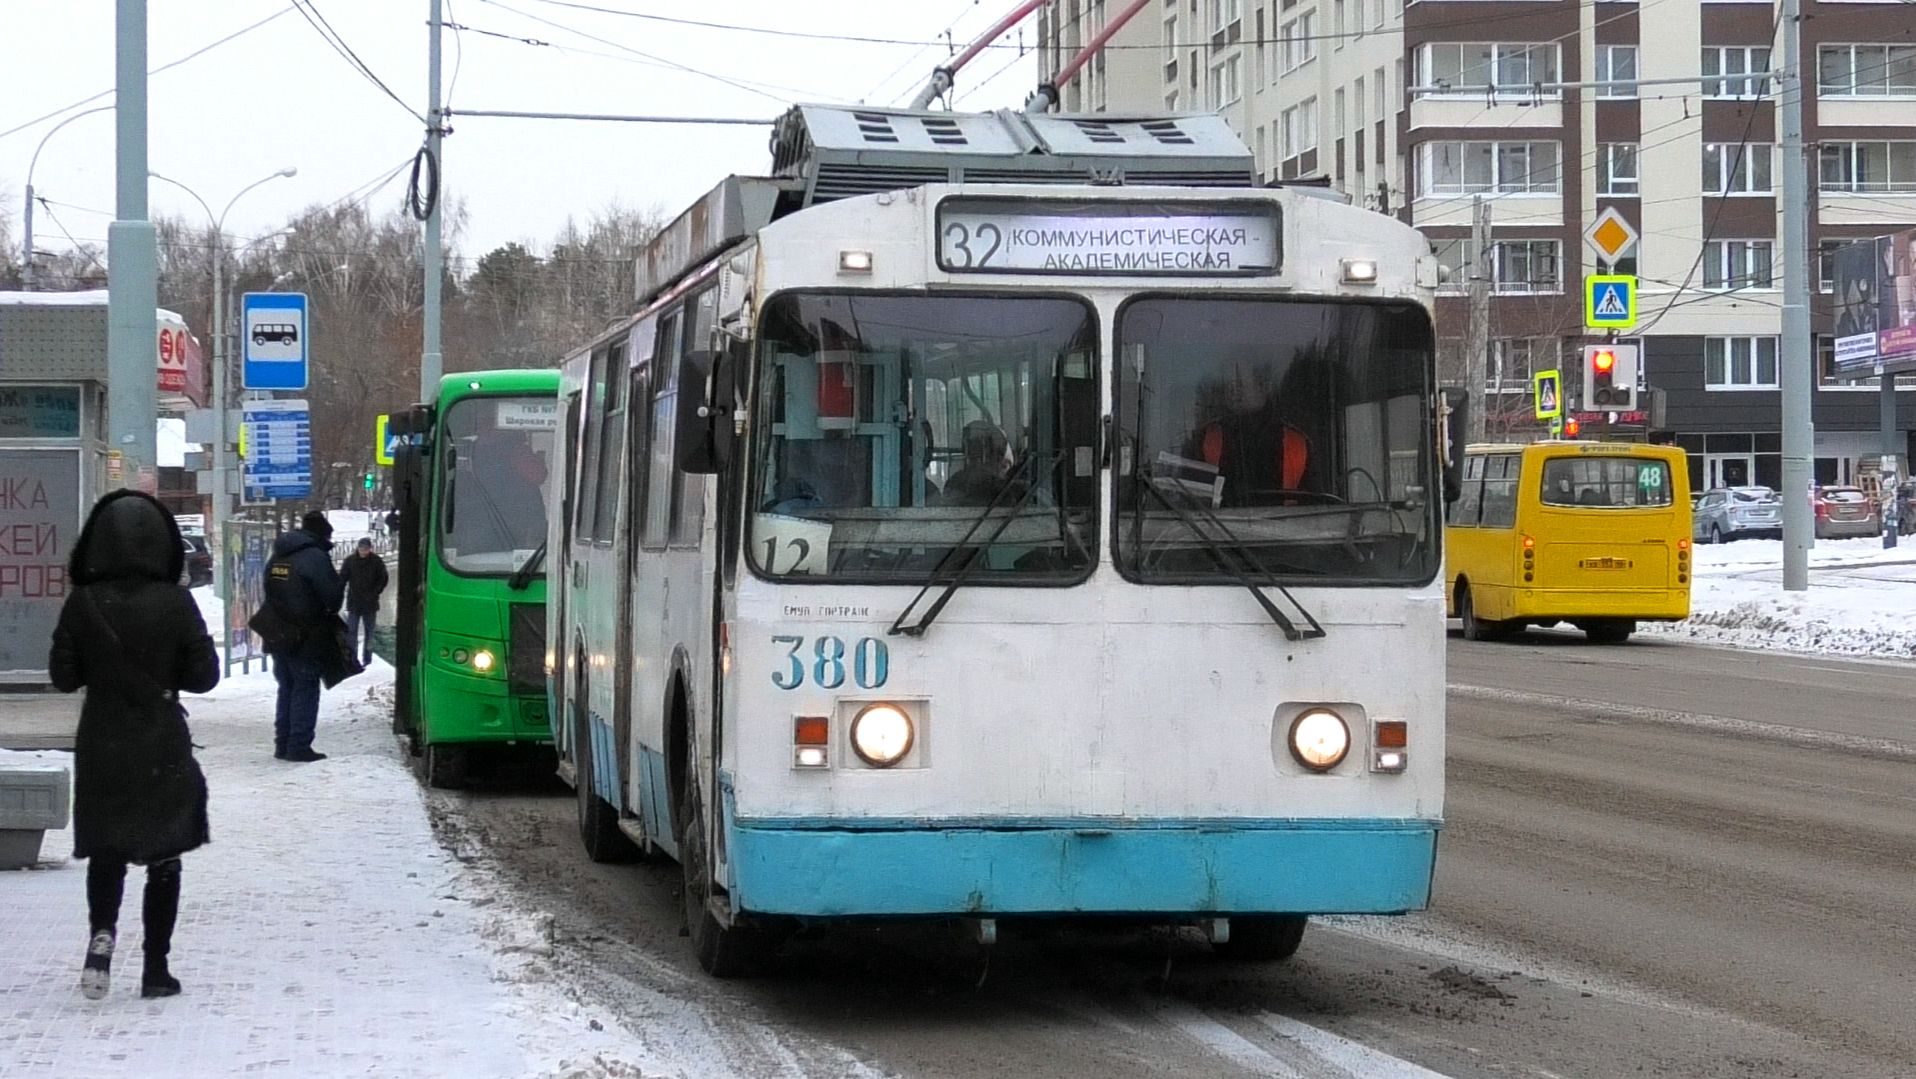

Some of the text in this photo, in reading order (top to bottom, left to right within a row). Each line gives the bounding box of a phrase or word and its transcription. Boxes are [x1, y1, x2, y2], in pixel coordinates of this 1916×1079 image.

[944, 222, 1002, 268] 32
[1011, 228, 1247, 247] КОММУНИСТИЧЕСКАЯ
[1043, 252, 1231, 269] АКАДЕМИЧЕСКАЯ
[1639, 467, 1662, 487] 48
[761, 535, 810, 576] 12
[783, 605, 810, 616] ЕМУП
[771, 635, 889, 690] 380
